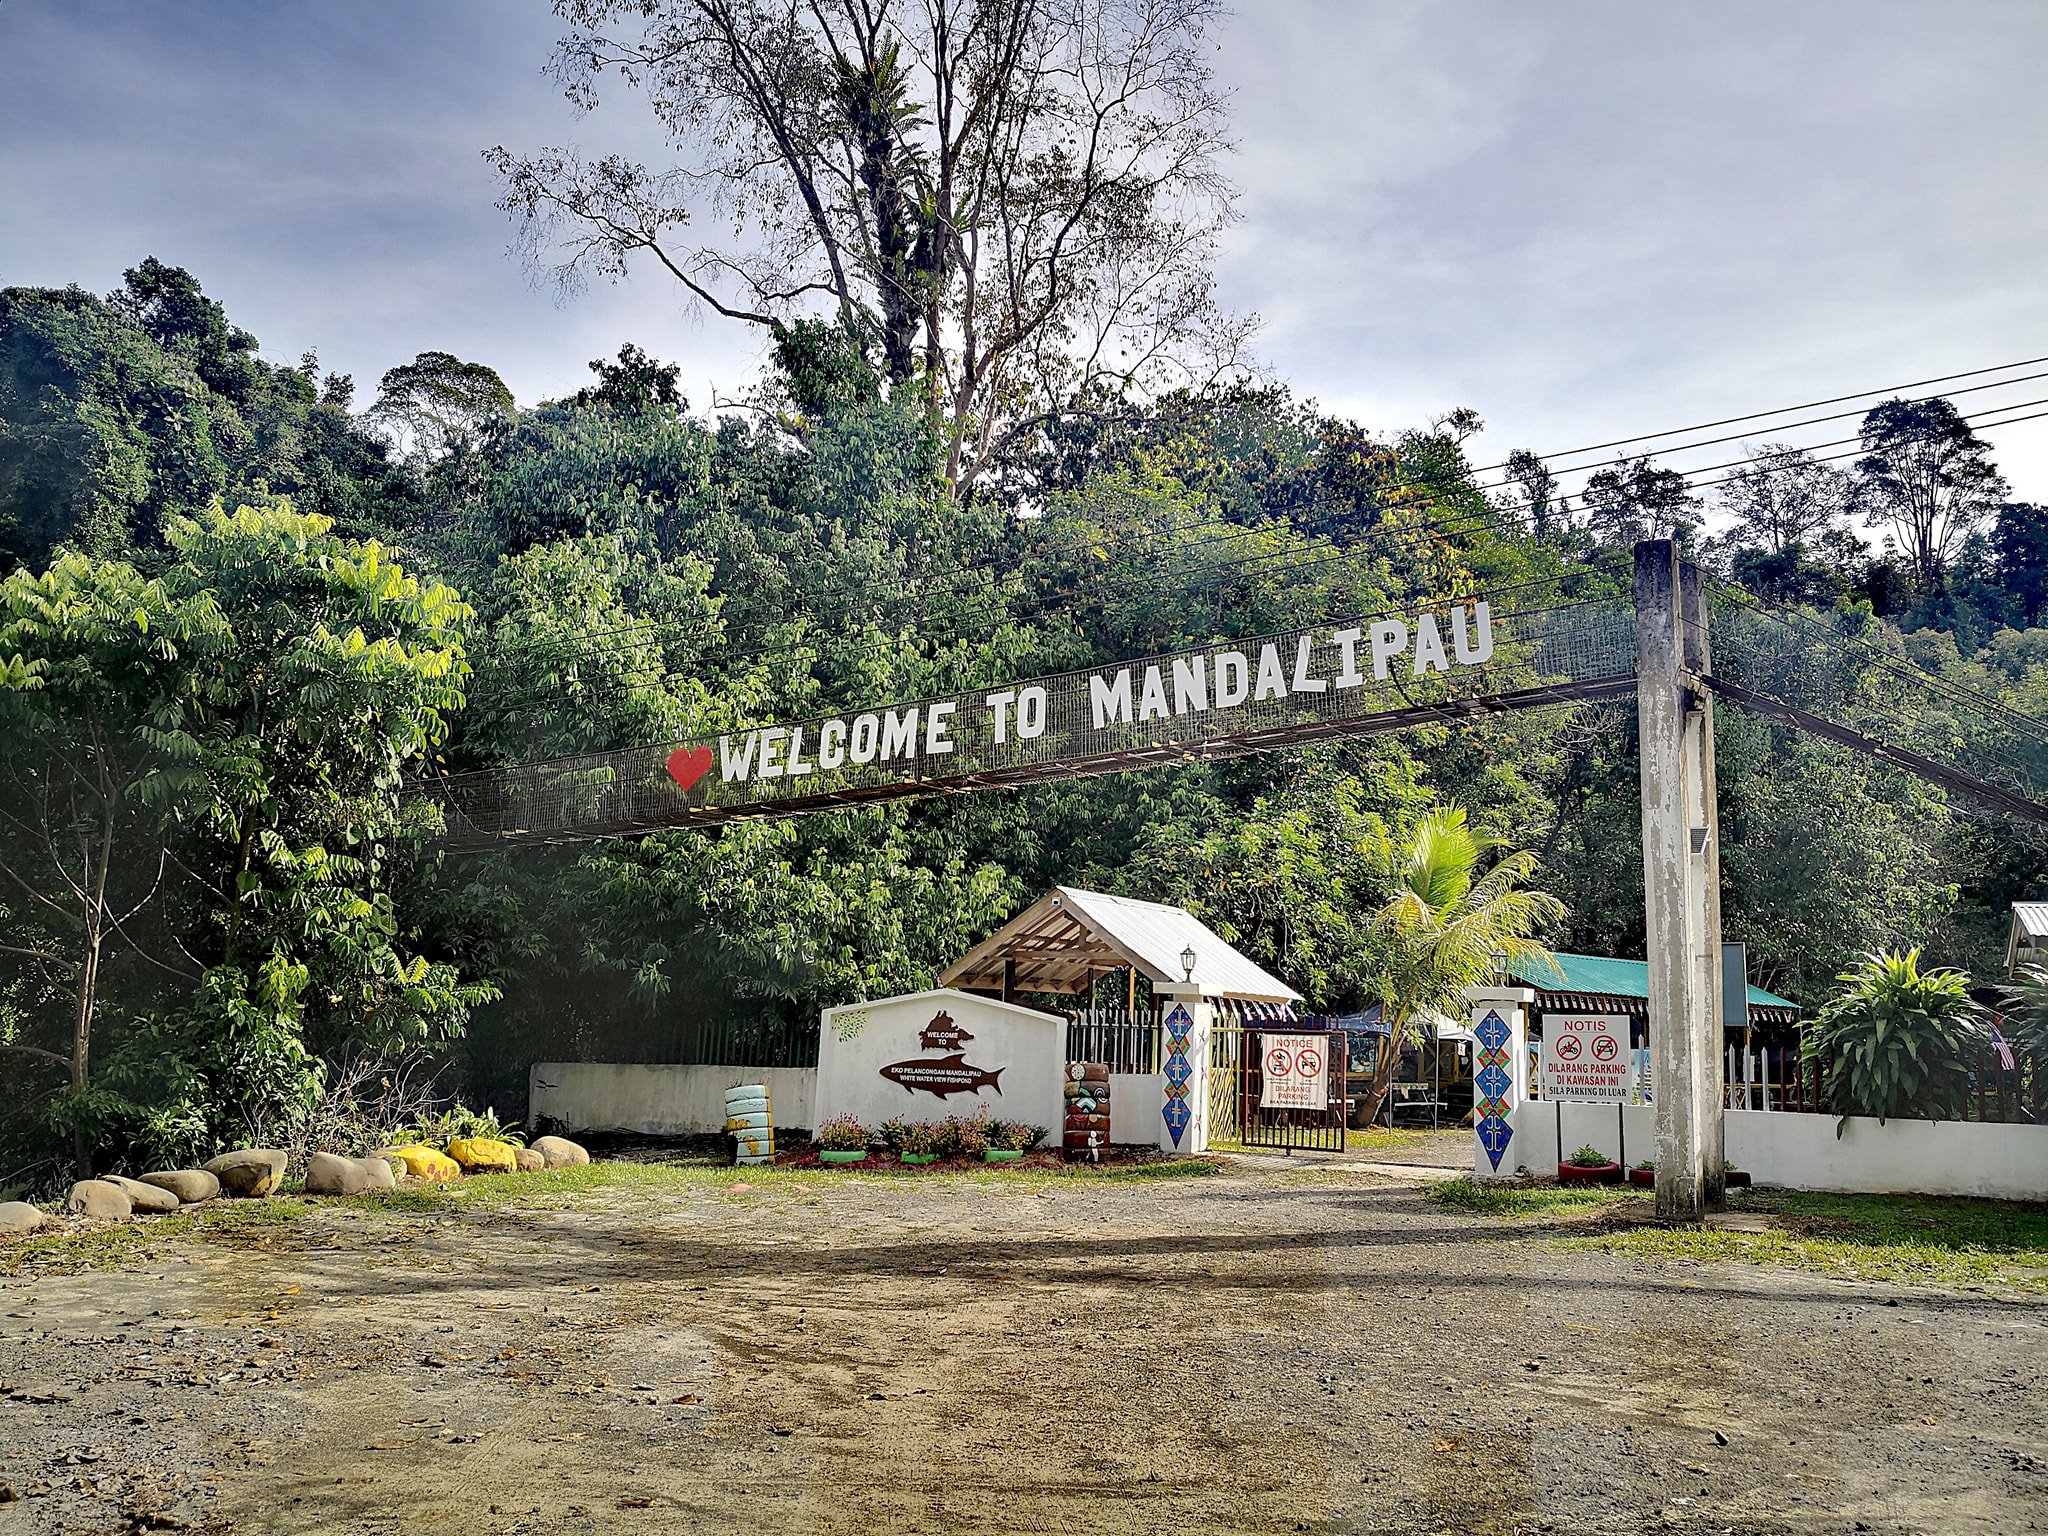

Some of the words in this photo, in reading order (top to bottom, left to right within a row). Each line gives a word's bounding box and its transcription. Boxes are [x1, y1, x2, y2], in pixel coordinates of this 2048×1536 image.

[718, 700, 956, 784] WELCOME
[985, 684, 1048, 745] TO
[1089, 600, 1493, 730] MANDALIPAU
[1564, 1020, 1606, 1032] NOTIS
[927, 1031, 959, 1039] WELCOME
[937, 1038, 947, 1046] TO
[1276, 1039, 1313, 1048] NOTICE
[903, 1067, 945, 1075] PELANCONGAN
[945, 1069, 982, 1077] MANDALIPAU
[1548, 1063, 1588, 1074] DILARANG
[1590, 1064, 1626, 1075] PARKING
[1556, 1075, 1564, 1085] DI
[1566, 1075, 1606, 1086] KAWASAN
[1608, 1076, 1619, 1087] INI
[1275, 1085, 1311, 1093] DILARANG
[1549, 1086, 1565, 1095] SILA
[1565, 1087, 1598, 1096] PARKING
[1599, 1087, 1607, 1096] DI
[1608, 1088, 1627, 1097] LUAR
